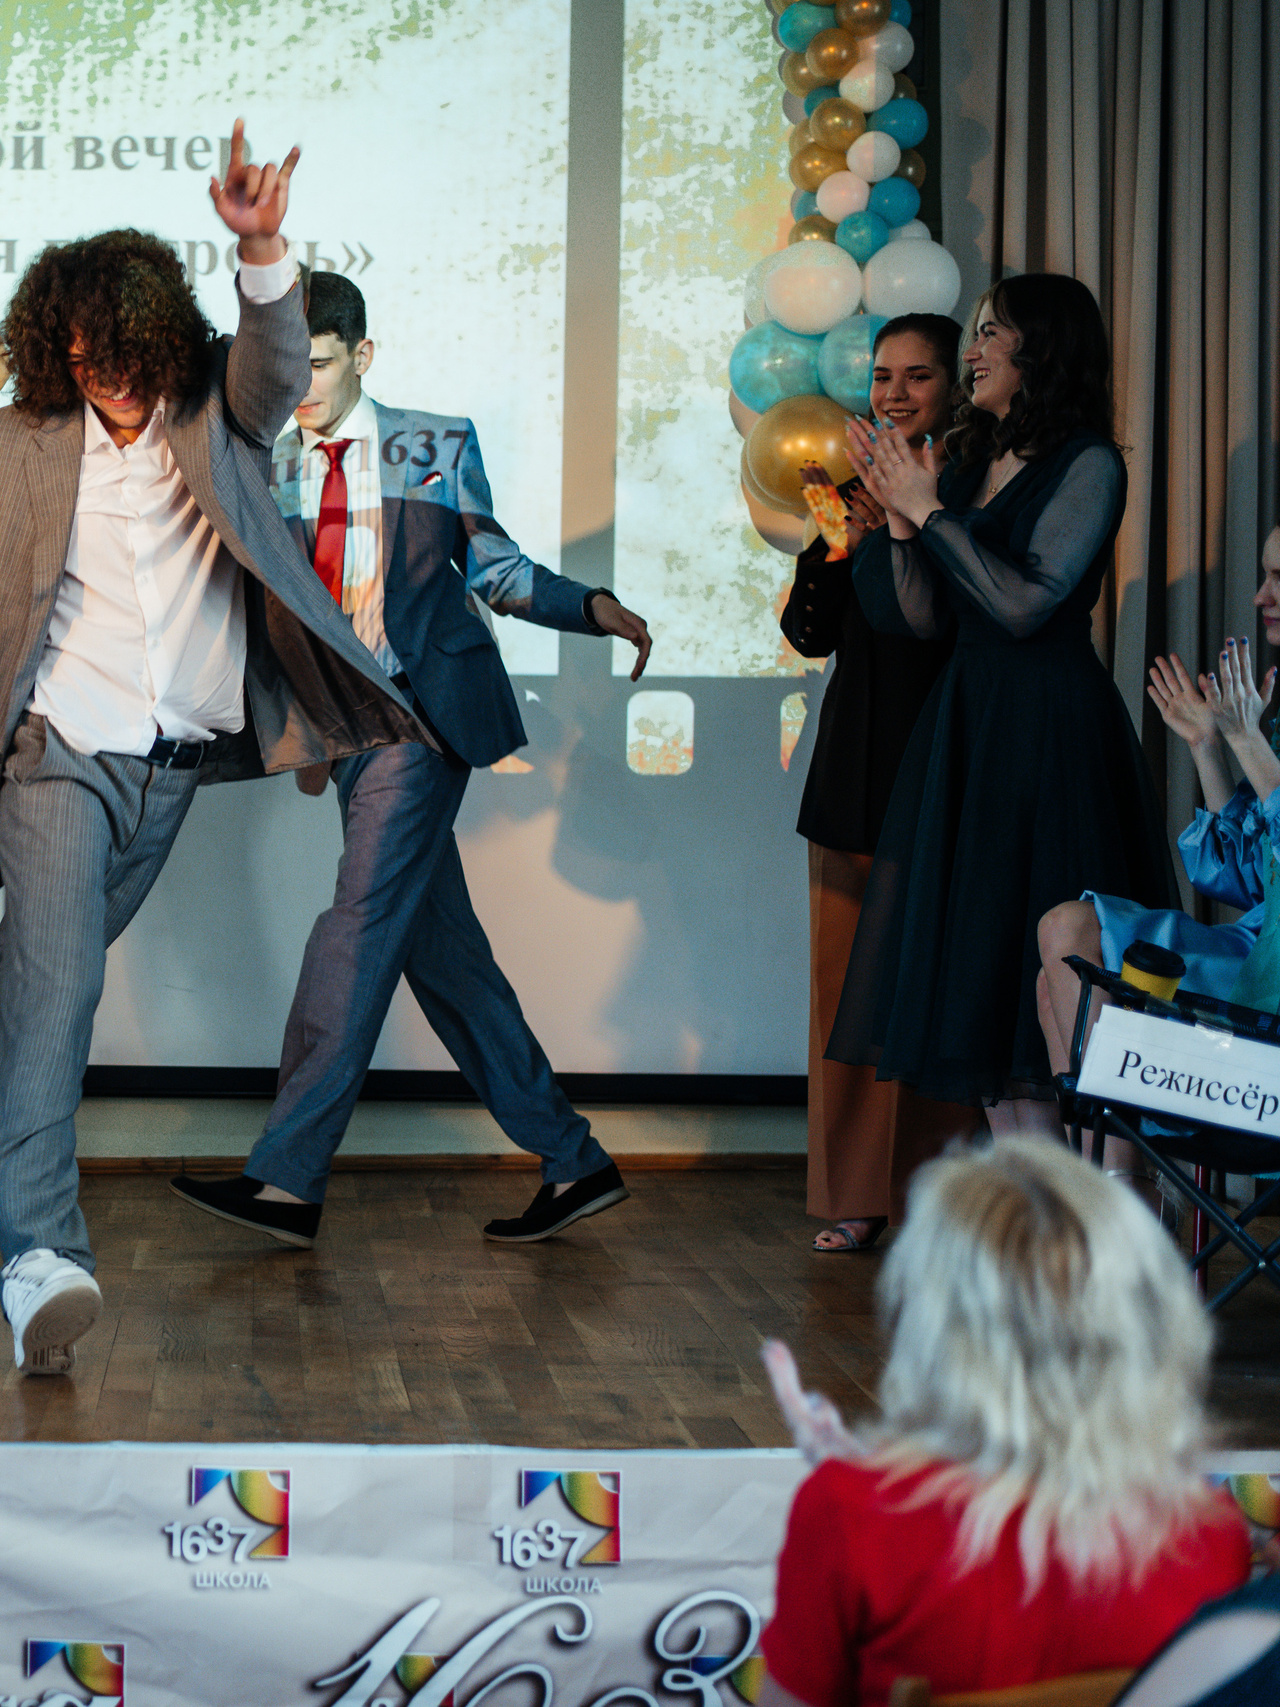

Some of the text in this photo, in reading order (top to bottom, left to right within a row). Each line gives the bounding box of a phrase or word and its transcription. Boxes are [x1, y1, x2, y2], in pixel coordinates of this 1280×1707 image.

[1117, 1049, 1280, 1122] Режиссёр
[163, 1517, 258, 1565] 1637
[493, 1519, 588, 1569] 1637
[194, 1570, 273, 1588] ШКОЛА
[525, 1576, 604, 1594] ШКОЛА
